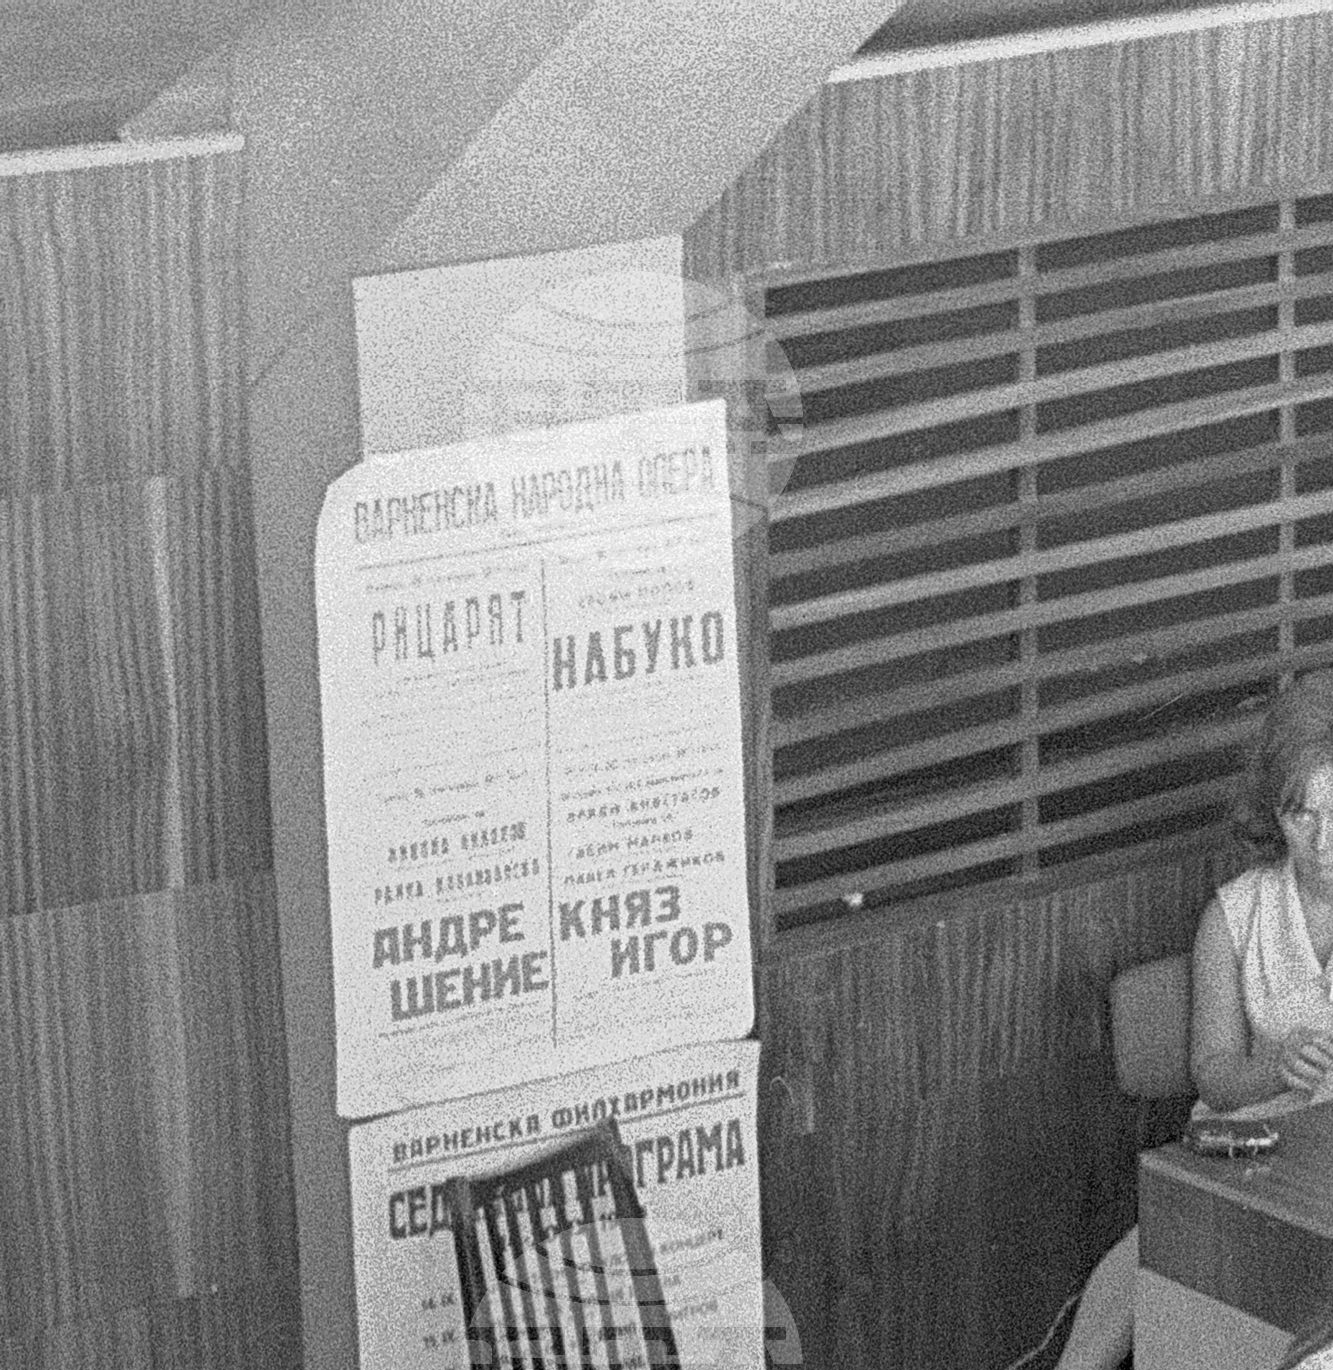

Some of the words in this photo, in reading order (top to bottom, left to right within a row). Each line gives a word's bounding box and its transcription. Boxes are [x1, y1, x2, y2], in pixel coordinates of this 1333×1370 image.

[354, 481, 497, 544] ВАРНЕНСКА
[511, 460, 625, 519] НАРОДНА
[637, 446, 713, 497] ОПЕРА
[371, 590, 527, 667] РИЦАРЯТ
[552, 610, 724, 692] НАБУКО
[372, 901, 526, 969] АНДРЕ
[558, 885, 681, 941] КНЯЗ
[610, 921, 733, 979] ИГОР
[390, 950, 550, 1022] ШЕНИЕ
[392, 1111, 541, 1163] ВАРНЕНСКА
[551, 1069, 741, 1129] ФИЛХАРМОНИЯ
